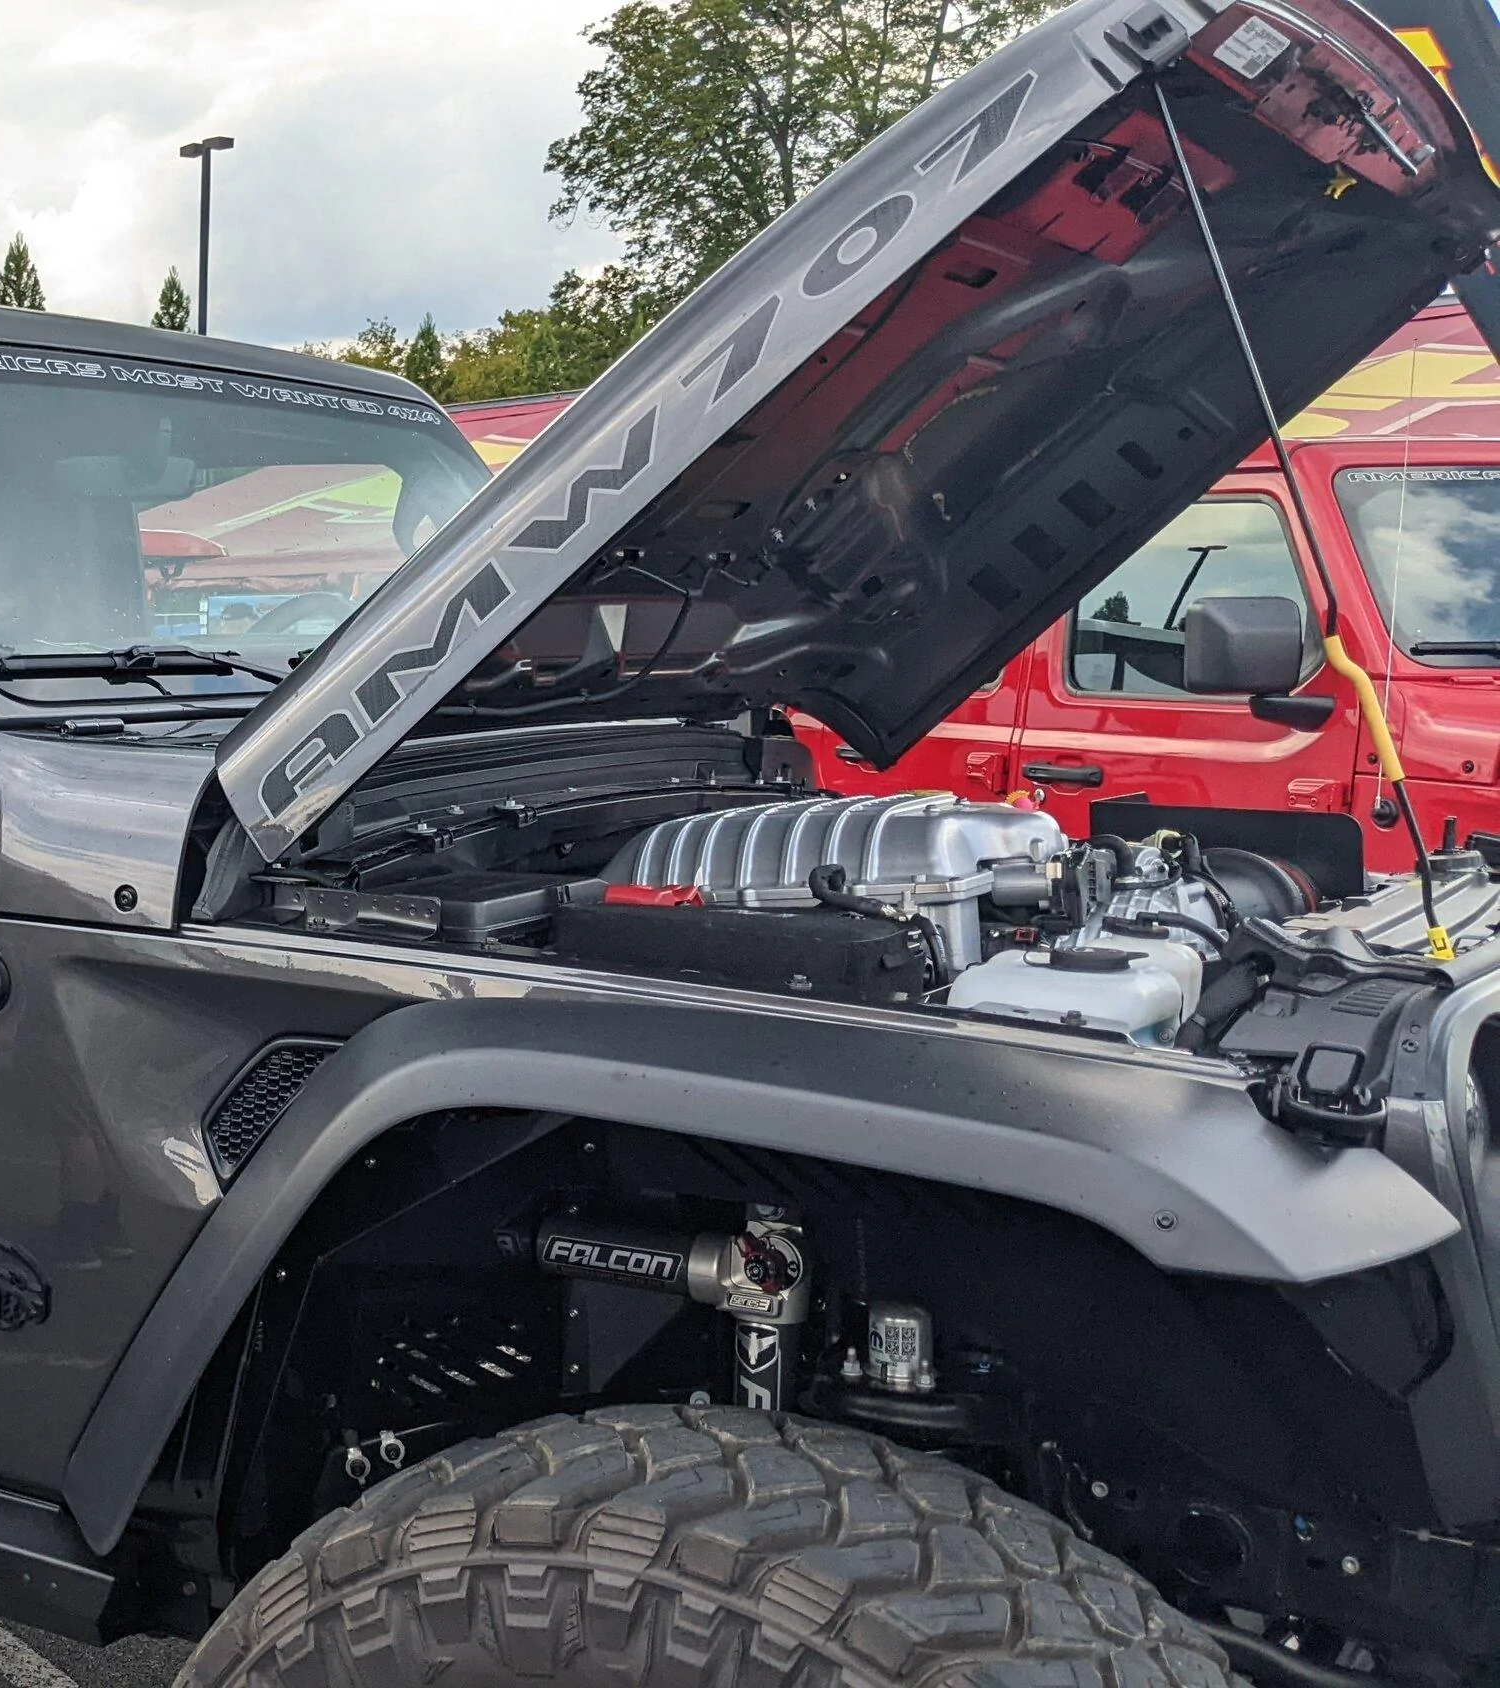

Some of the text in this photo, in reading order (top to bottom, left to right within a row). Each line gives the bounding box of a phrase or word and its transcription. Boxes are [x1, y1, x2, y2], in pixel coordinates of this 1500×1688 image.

[110, 366, 224, 394] MOST
[229, 382, 384, 416] WANTED
[257, 396, 663, 821] AMW
[677, 69, 1039, 416] 707
[550, 1241, 673, 1278] FALCON
